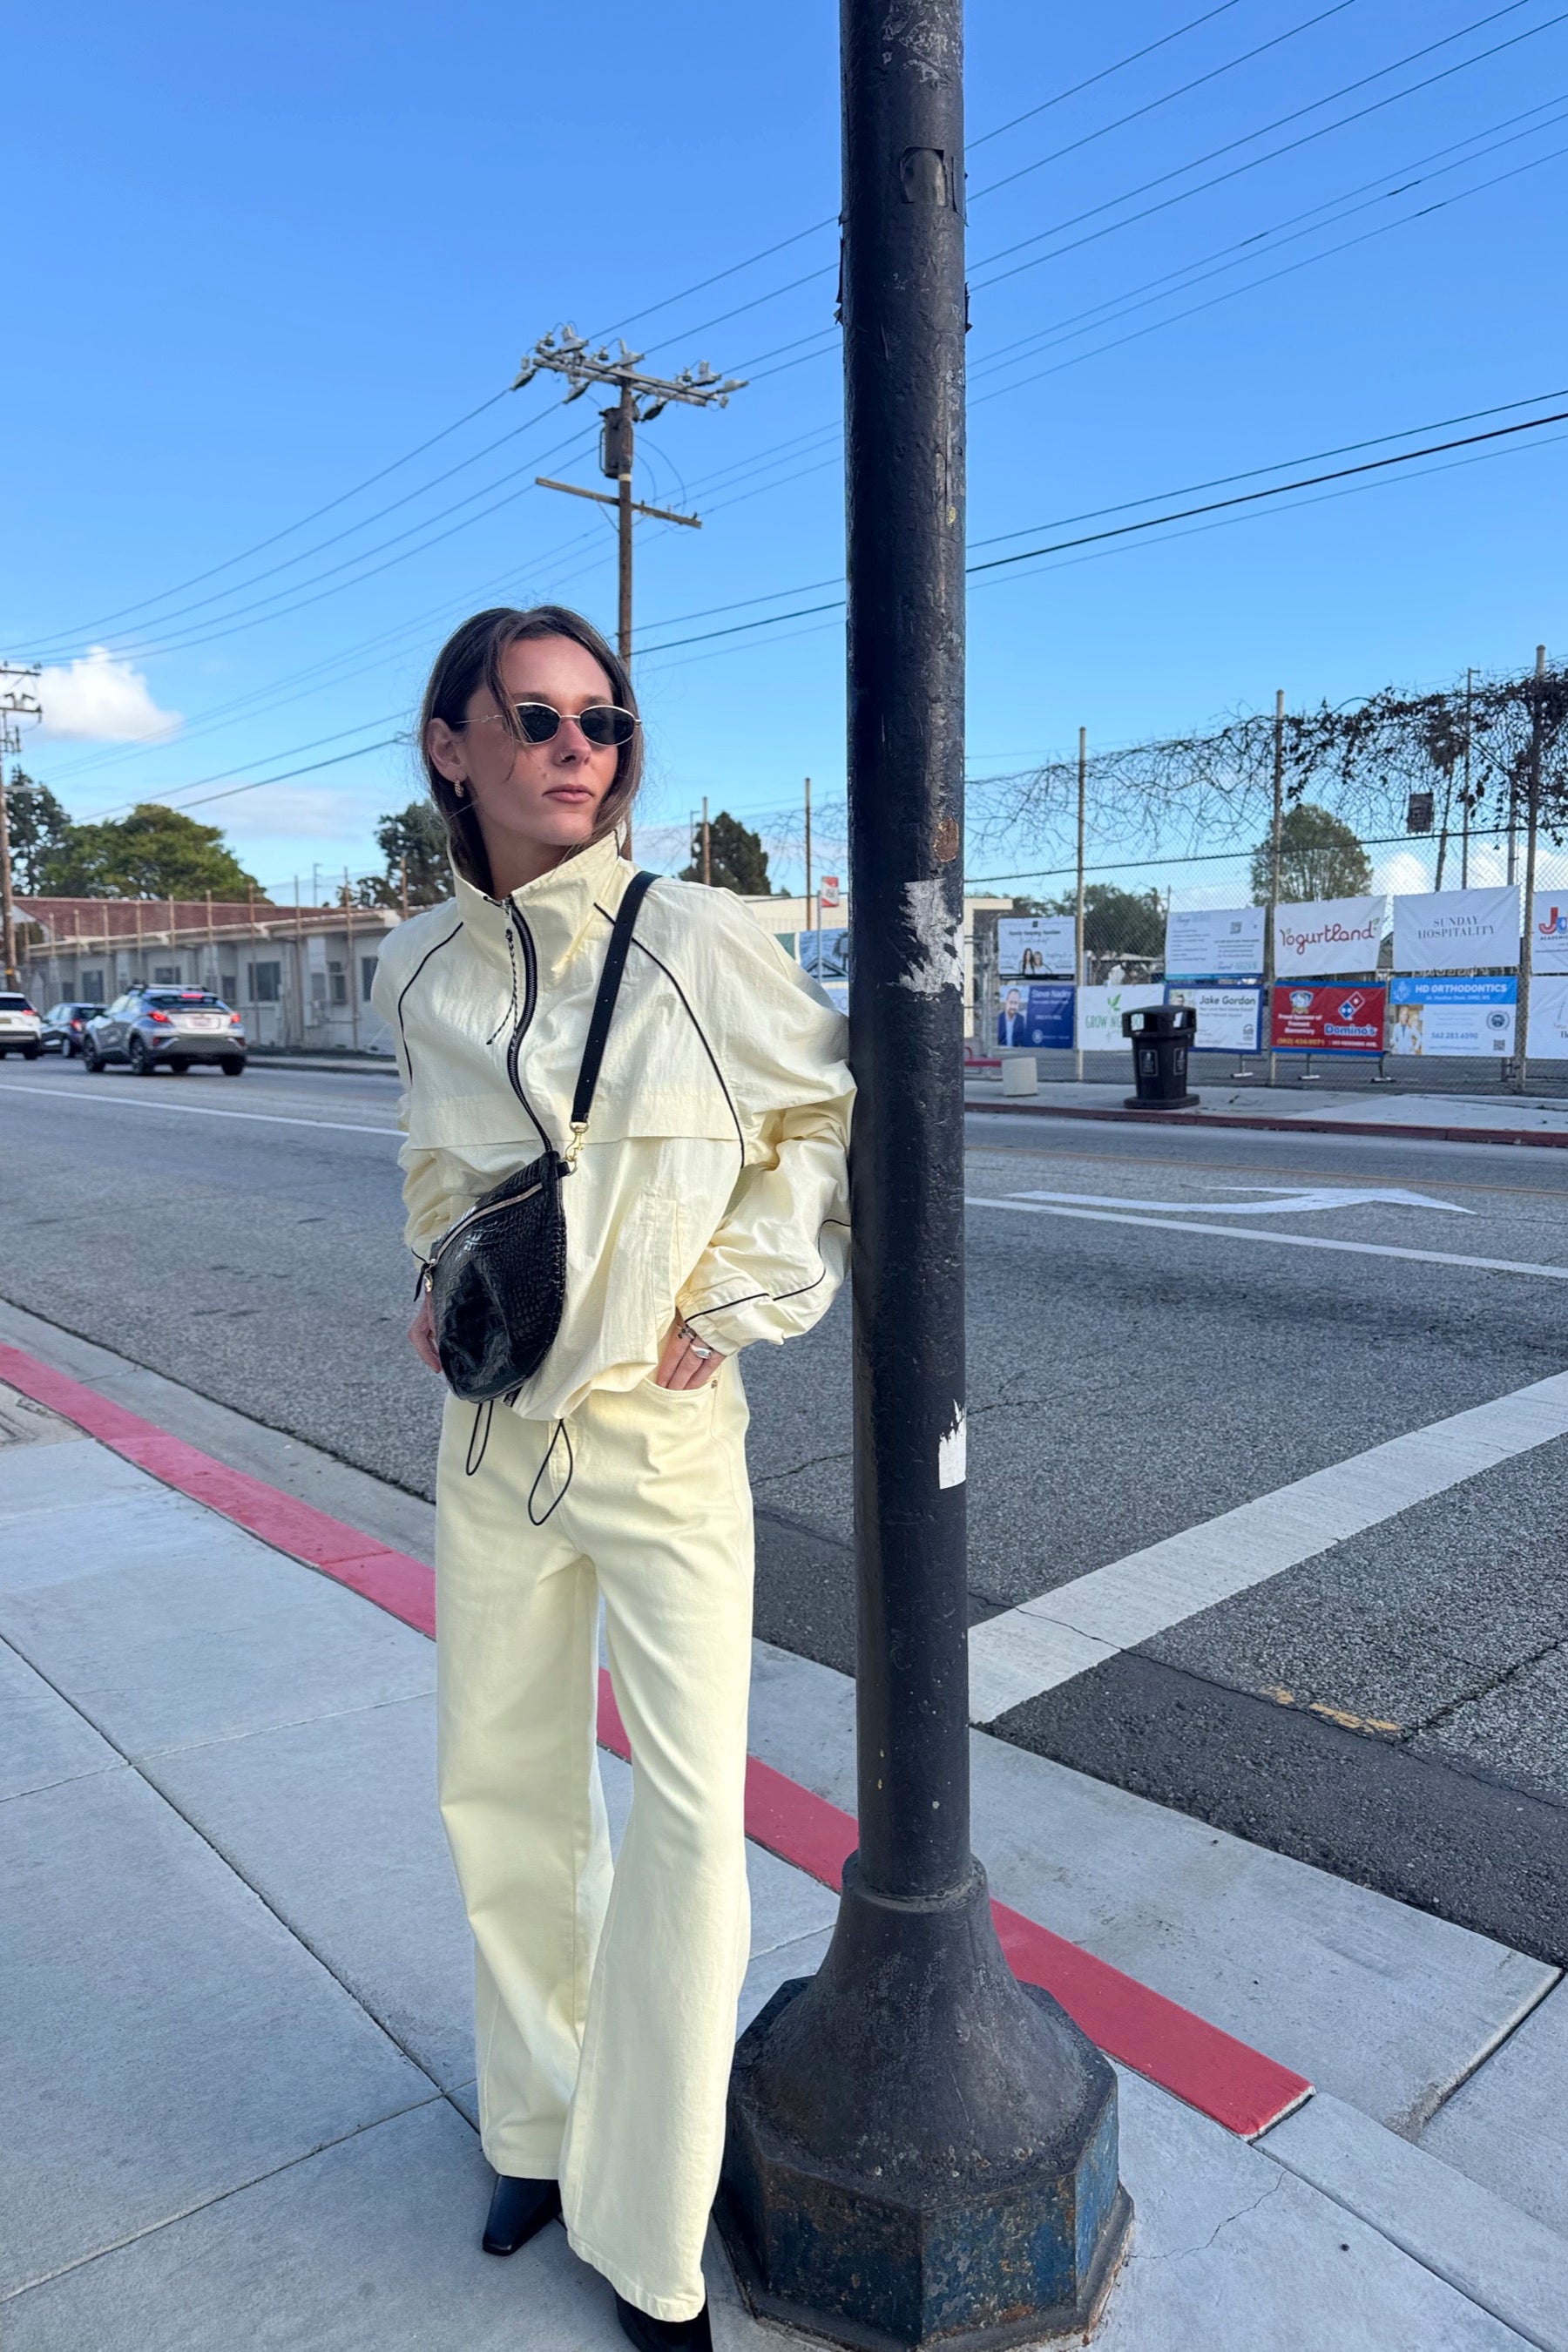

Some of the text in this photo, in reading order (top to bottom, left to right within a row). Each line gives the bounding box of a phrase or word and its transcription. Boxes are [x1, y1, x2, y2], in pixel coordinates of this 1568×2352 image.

[1434, 916, 1478, 927] SUNDAY
[1279, 921, 1375, 955] Yogurtland
[1418, 925, 1495, 939] HOSPITALITY
[1415, 983, 1507, 993] HD ORTHODONTICS
[1200, 995, 1256, 1005] Jake Gordon
[1325, 1024, 1376, 1037] Domino's
